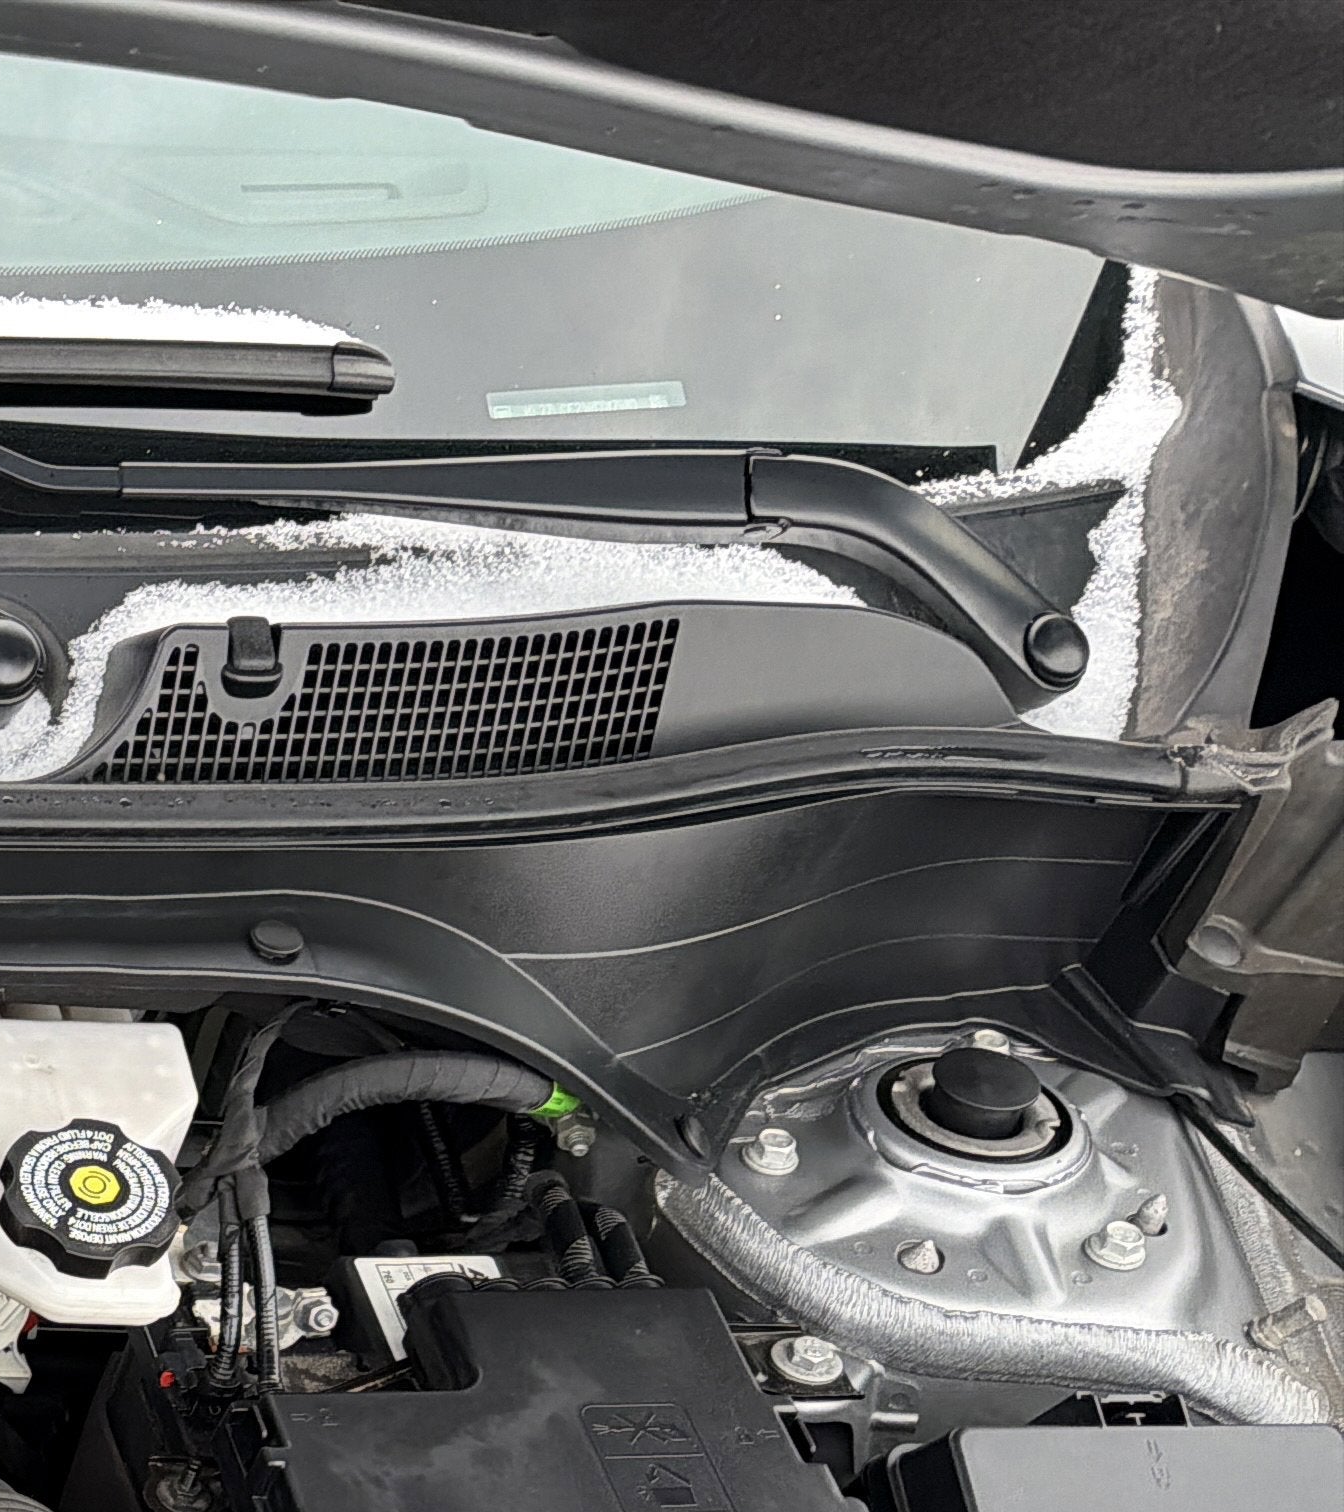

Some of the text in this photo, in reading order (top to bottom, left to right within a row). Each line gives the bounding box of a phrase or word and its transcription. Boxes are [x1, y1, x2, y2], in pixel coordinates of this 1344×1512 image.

[57, 1130, 85, 1141] FLUID
[93, 1131, 114, 1142] DOT
[33, 1135, 59, 1152] FROM
[52, 1140, 88, 1154] BEFORE
[89, 1141, 112, 1151] CAP
[20, 1155, 36, 1182] SEALED
[48, 1160, 66, 1183] CLEAN
[35, 1186, 49, 1199] USE
[49, 1185, 72, 1210] FILLER
[42, 1198, 65, 1218] ONLY
[74, 1220, 90, 1230] DOT
[104, 1233, 132, 1241] AVANT
